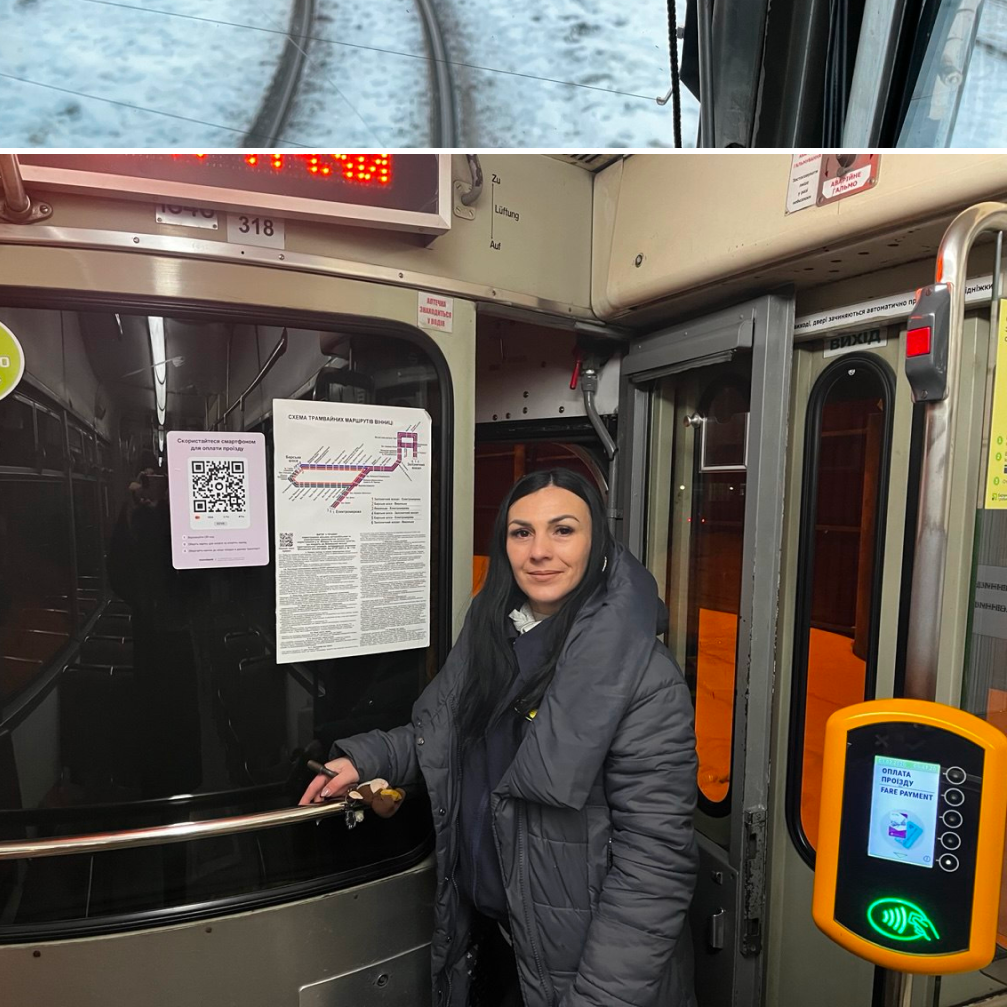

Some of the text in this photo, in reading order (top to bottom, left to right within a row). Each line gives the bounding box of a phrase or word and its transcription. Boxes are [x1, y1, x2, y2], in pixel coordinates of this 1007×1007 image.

[492, 173, 501, 184] Zu
[494, 204, 520, 222] Lüftung
[238, 216, 274, 237] 318
[490, 240, 501, 250] Auf
[828, 309, 866, 322] зачиняються
[866, 300, 908, 314] автоматично
[965, 283, 993, 295] ідніжки
[829, 328, 881, 351] ВИХІД
[882, 767, 912, 778] ОПЛАТА
[881, 776, 914, 788] ПРОЇЗДУ
[880, 786, 934, 801] FARE PAYMENT
